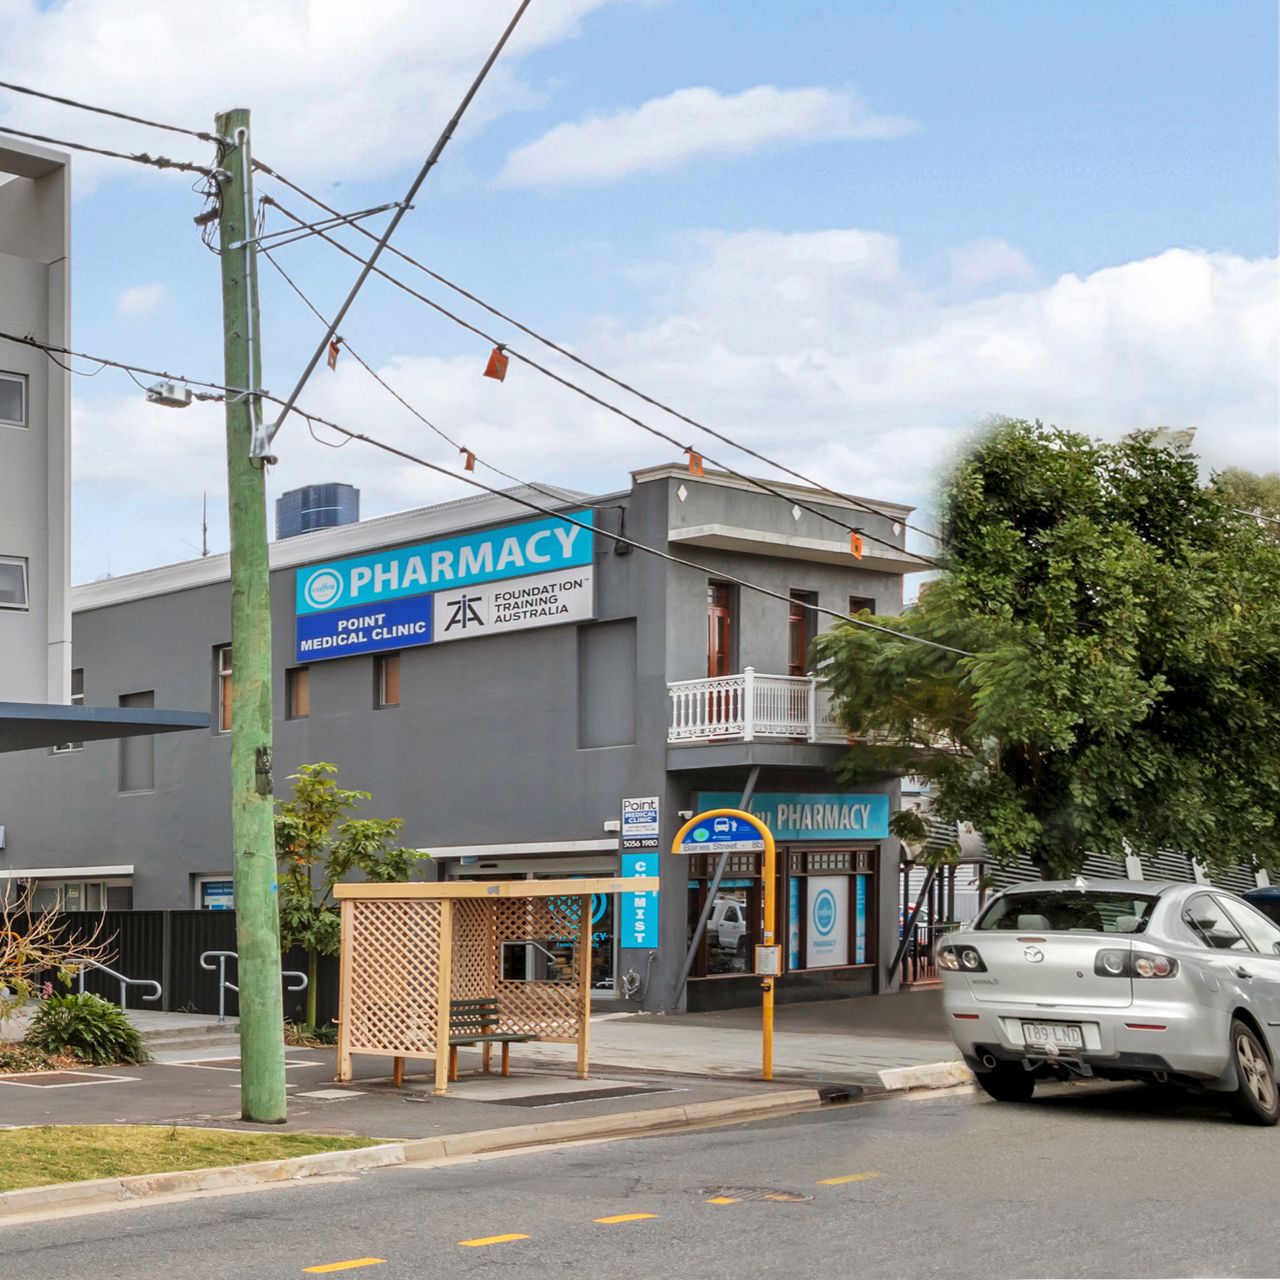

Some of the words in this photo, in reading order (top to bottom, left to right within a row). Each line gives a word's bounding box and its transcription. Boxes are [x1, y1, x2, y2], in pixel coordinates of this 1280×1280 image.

[350, 524, 582, 597] PHARMACY
[495, 579, 583, 602] FOUNDATION
[495, 595, 558, 613] TRAINING
[337, 613, 386, 632] POINT
[494, 604, 569, 624] AUSTRALIA
[300, 630, 367, 652] MEDICAL
[372, 620, 426, 641] CLINIC
[623, 799, 657, 811] Point
[624, 810, 656, 818] MEDICAL
[777, 804, 871, 830] PHARMACY
[712, 842, 738, 850] Street
